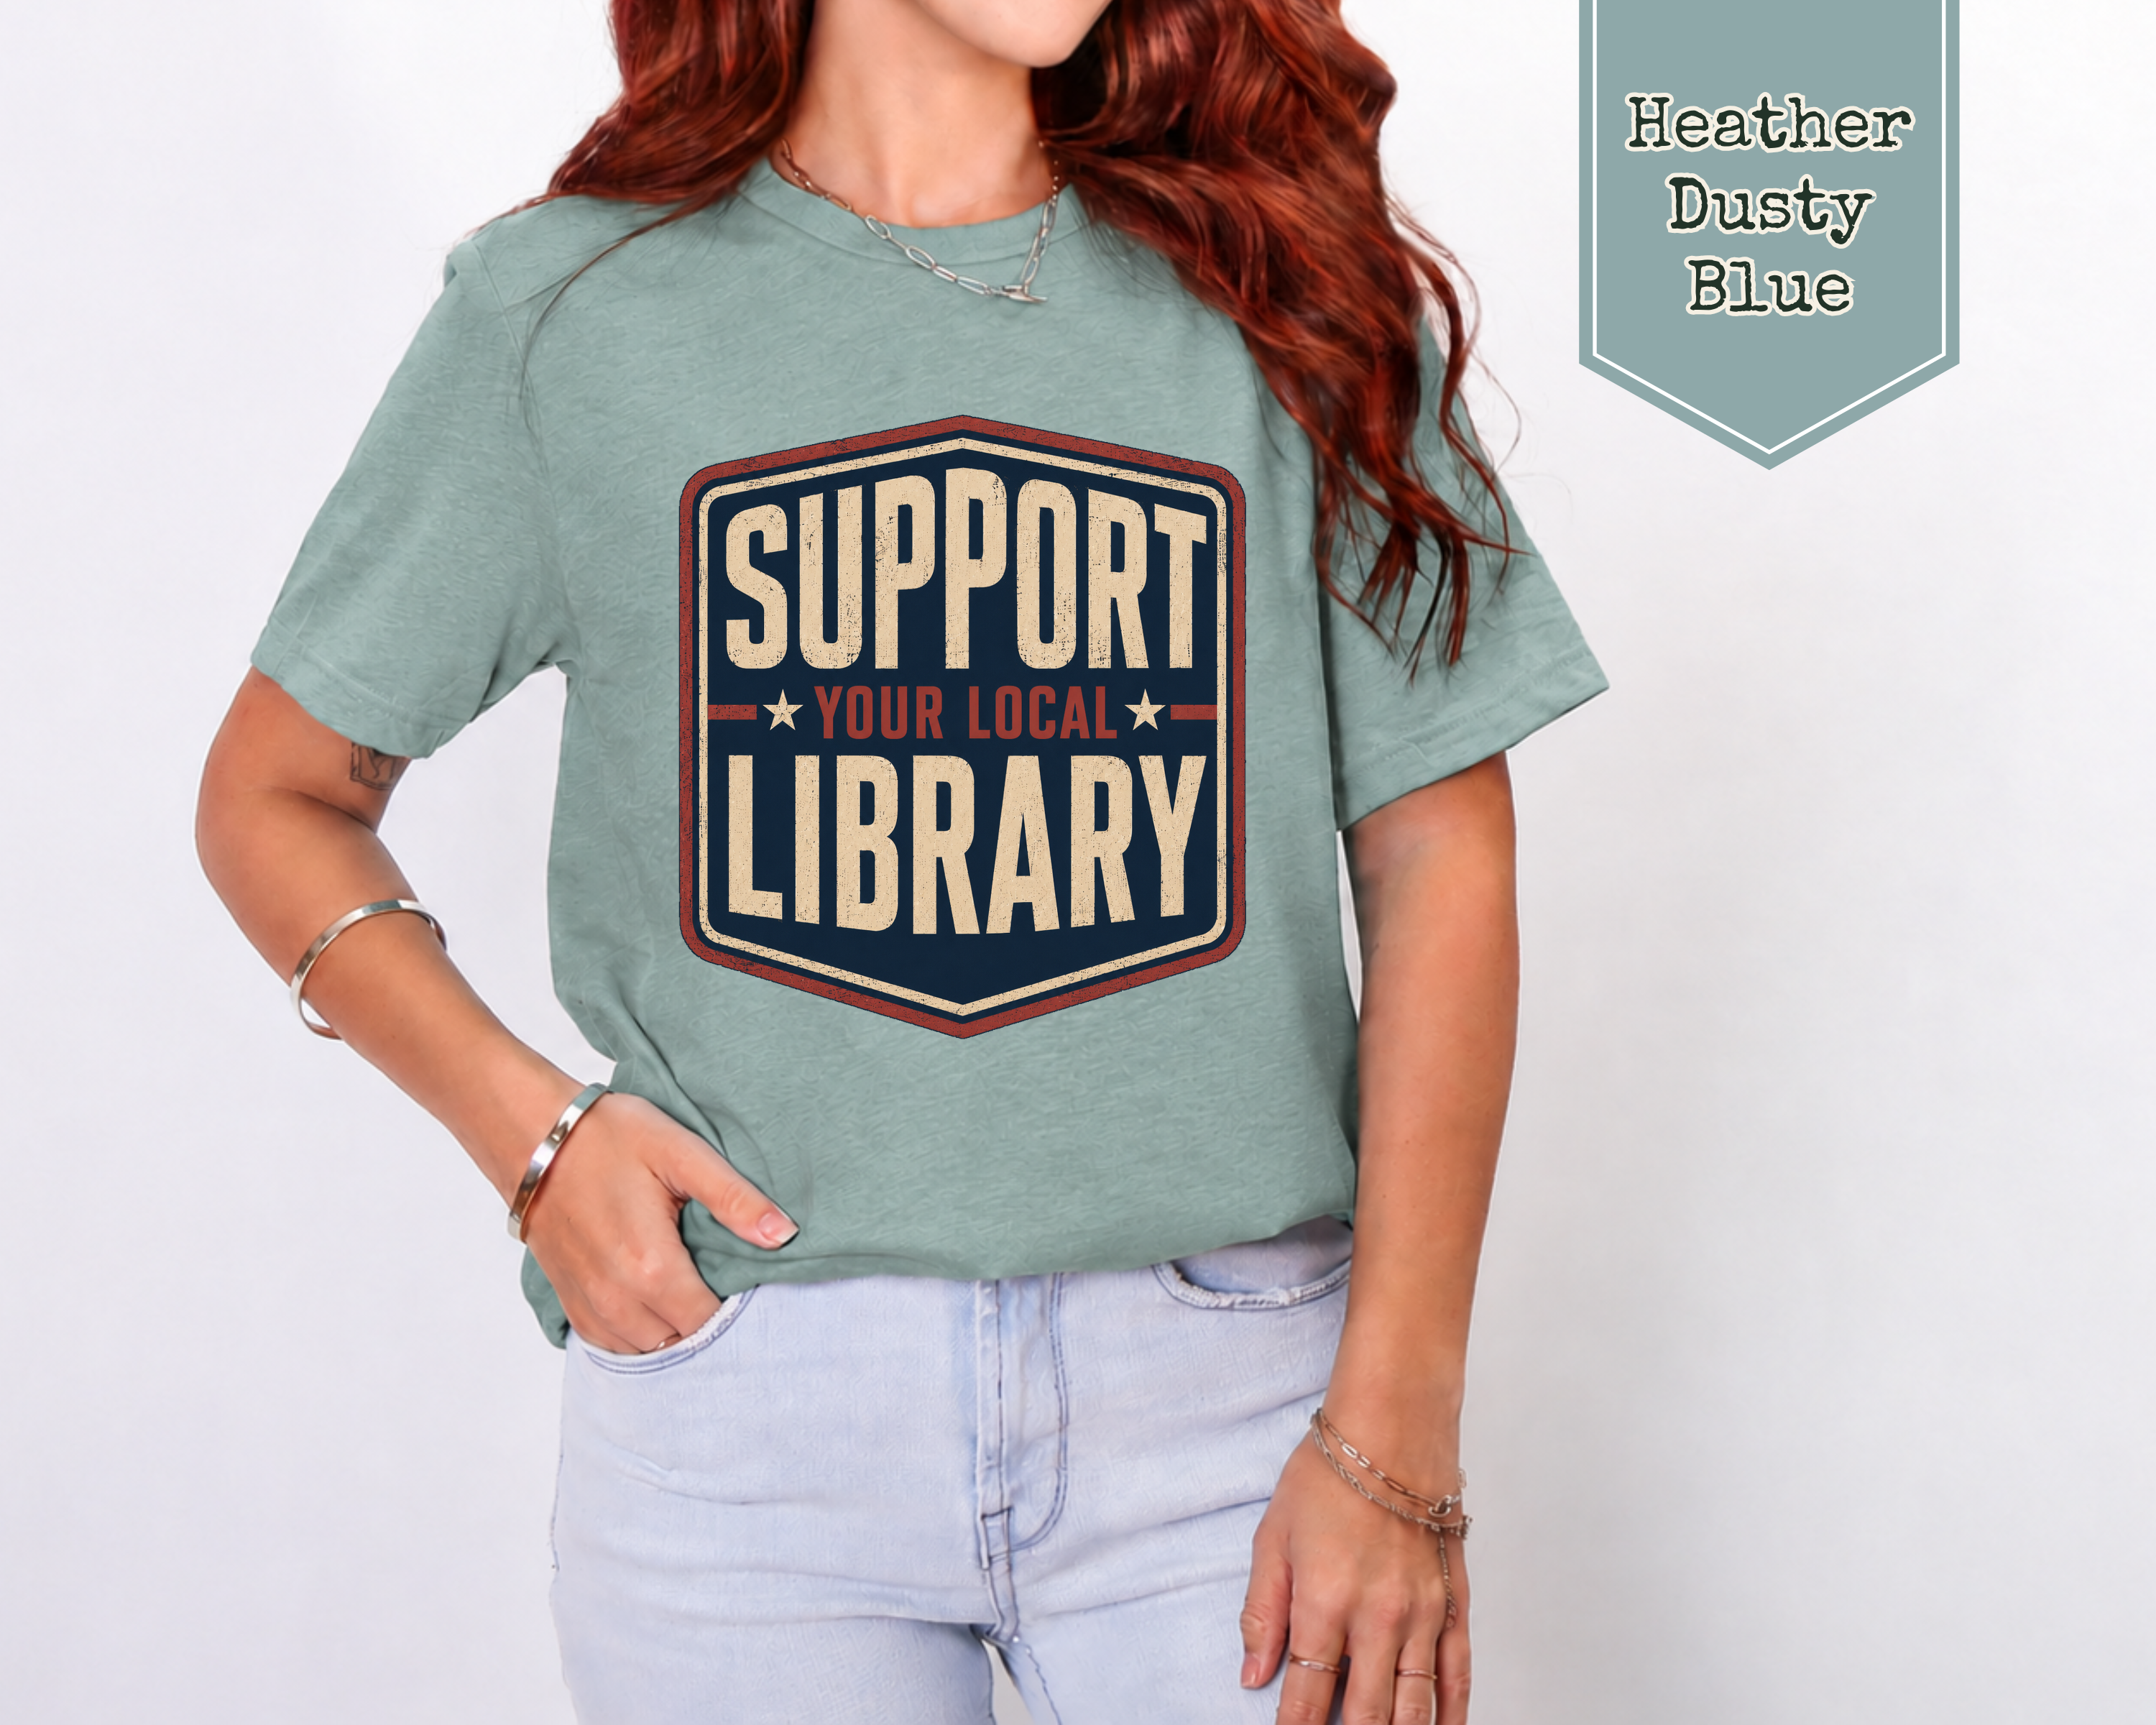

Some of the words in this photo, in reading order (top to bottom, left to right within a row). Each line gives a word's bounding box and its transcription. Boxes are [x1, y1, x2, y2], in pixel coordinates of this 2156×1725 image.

[725, 467, 1207, 670] SUPPORT
[814, 685, 944, 740] YOUR
[968, 685, 1118, 740] LOCAL
[727, 755, 1207, 935] LIBRARY
